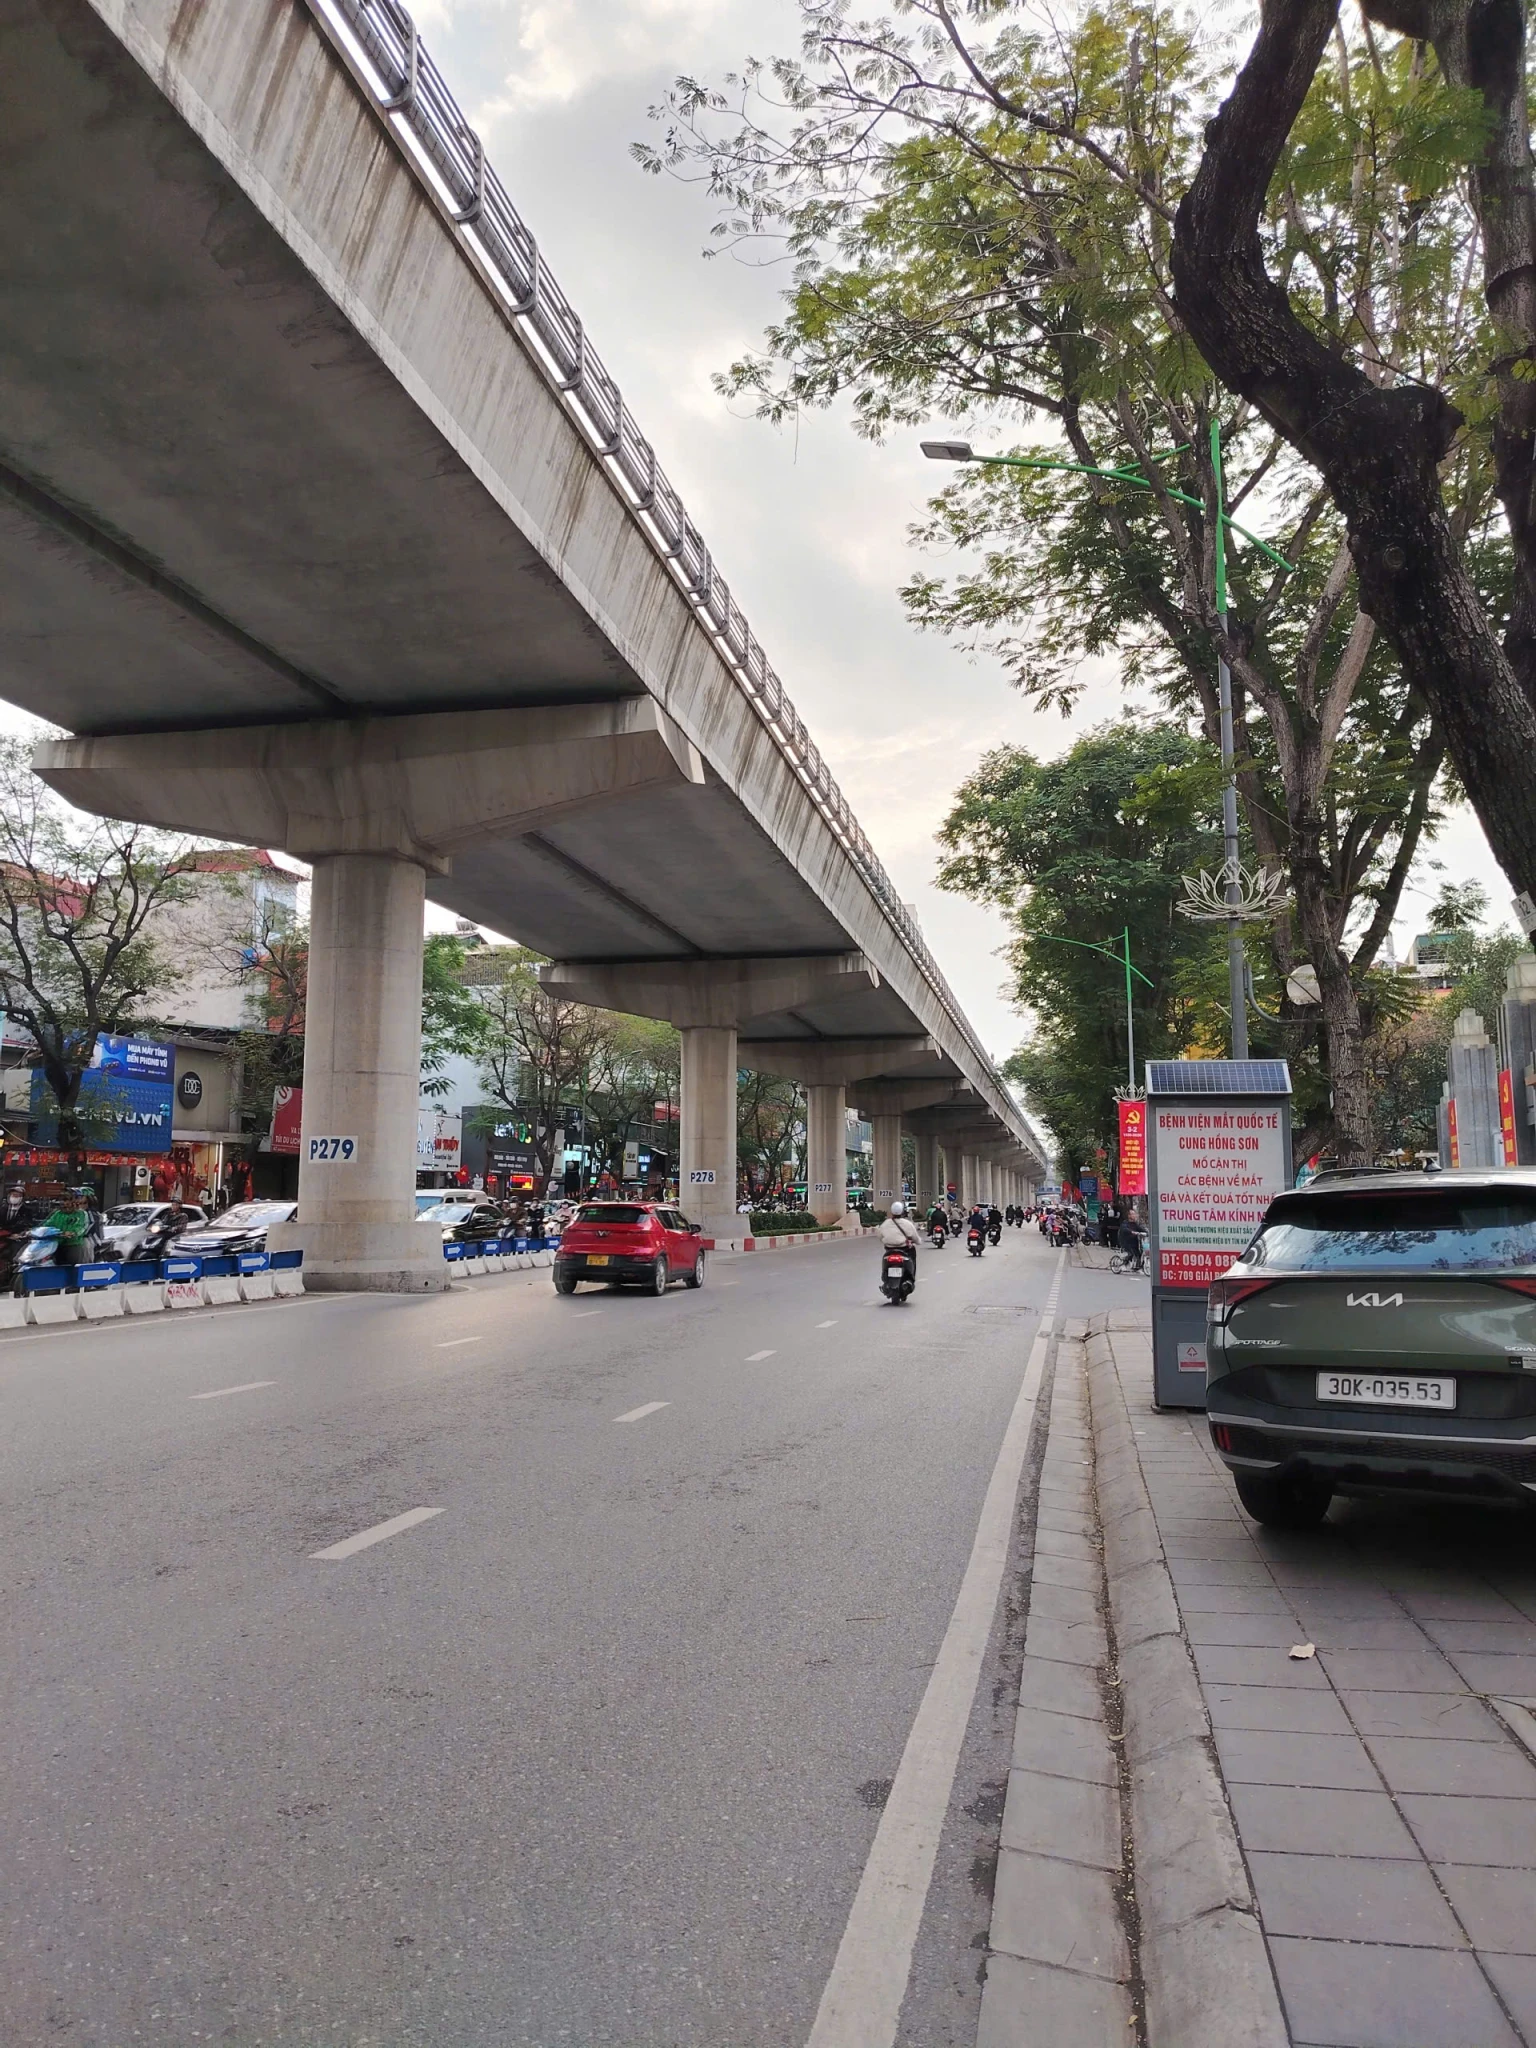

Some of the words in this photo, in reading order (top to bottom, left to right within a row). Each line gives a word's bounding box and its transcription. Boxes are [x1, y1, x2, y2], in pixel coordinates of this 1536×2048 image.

[127, 1044, 141, 1054] MUA
[140, 1057, 160, 1067] PHONG
[1159, 1113, 1185, 1131] BỆNH
[1188, 1113, 1211, 1131] VIỆN
[1213, 1111, 1234, 1129] MẮT
[1237, 1112, 1264, 1130] QUỐC
[1266, 1112, 1278, 1129] TẾ
[310, 1138, 354, 1160] P279
[1179, 1136, 1206, 1150] CUNG
[1238, 1136, 1259, 1150] SƠN
[1210, 1158, 1230, 1171] CẬN
[1231, 1159, 1247, 1171] THỊ
[691, 1171, 714, 1183] P278
[1178, 1174, 1197, 1187] CÁC
[1198, 1174, 1225, 1188] BỆNH
[1242, 1173, 1264, 1187] MẮT
[815, 1184, 831, 1192] P277
[1160, 1191, 1177, 1203] GIÁ
[1178, 1191, 1192, 1204] VÀ
[1193, 1190, 1210, 1204] KẾT
[1235, 1191, 1254, 1204] TỐT
[1162, 1209, 1200, 1221] TRUNG
[1202, 1208, 1226, 1221] TÂM
[1229, 1208, 1254, 1222] KÍNH
[1162, 1254, 1180, 1266] ĐT:
[1182, 1254, 1212, 1267] 0904
[1162, 1270, 1176, 1280] ĐC:
[1178, 1271, 1193, 1281] 709
[1195, 1268, 1213, 1281] GIẢI
[1346, 1293, 1403, 1307] KIA
[1329, 1378, 1441, 1401] 30K-035.53
